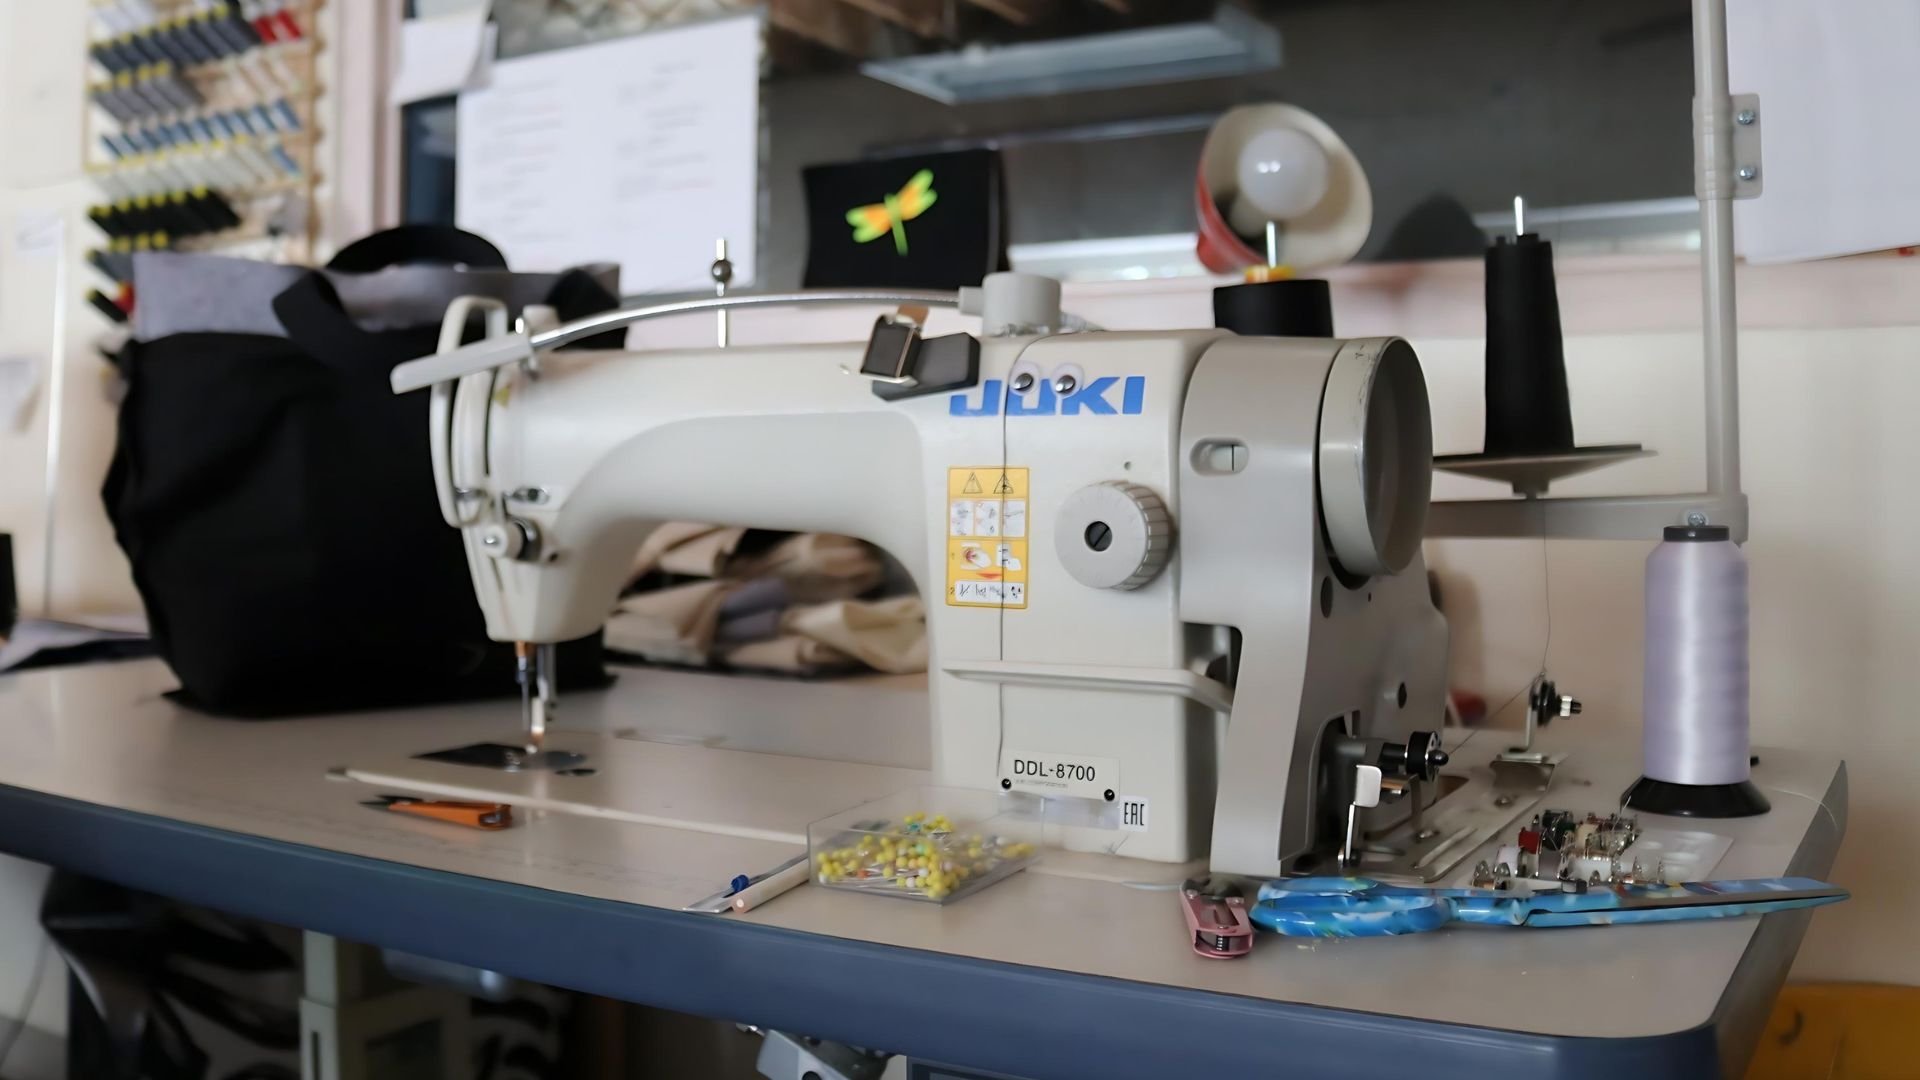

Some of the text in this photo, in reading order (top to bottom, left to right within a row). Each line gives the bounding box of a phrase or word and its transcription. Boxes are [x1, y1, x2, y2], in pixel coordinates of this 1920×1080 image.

[950, 376, 1145, 416] JUKI
[1014, 759, 1096, 781] DDL-8700
[1123, 802, 1145, 826] EAC
